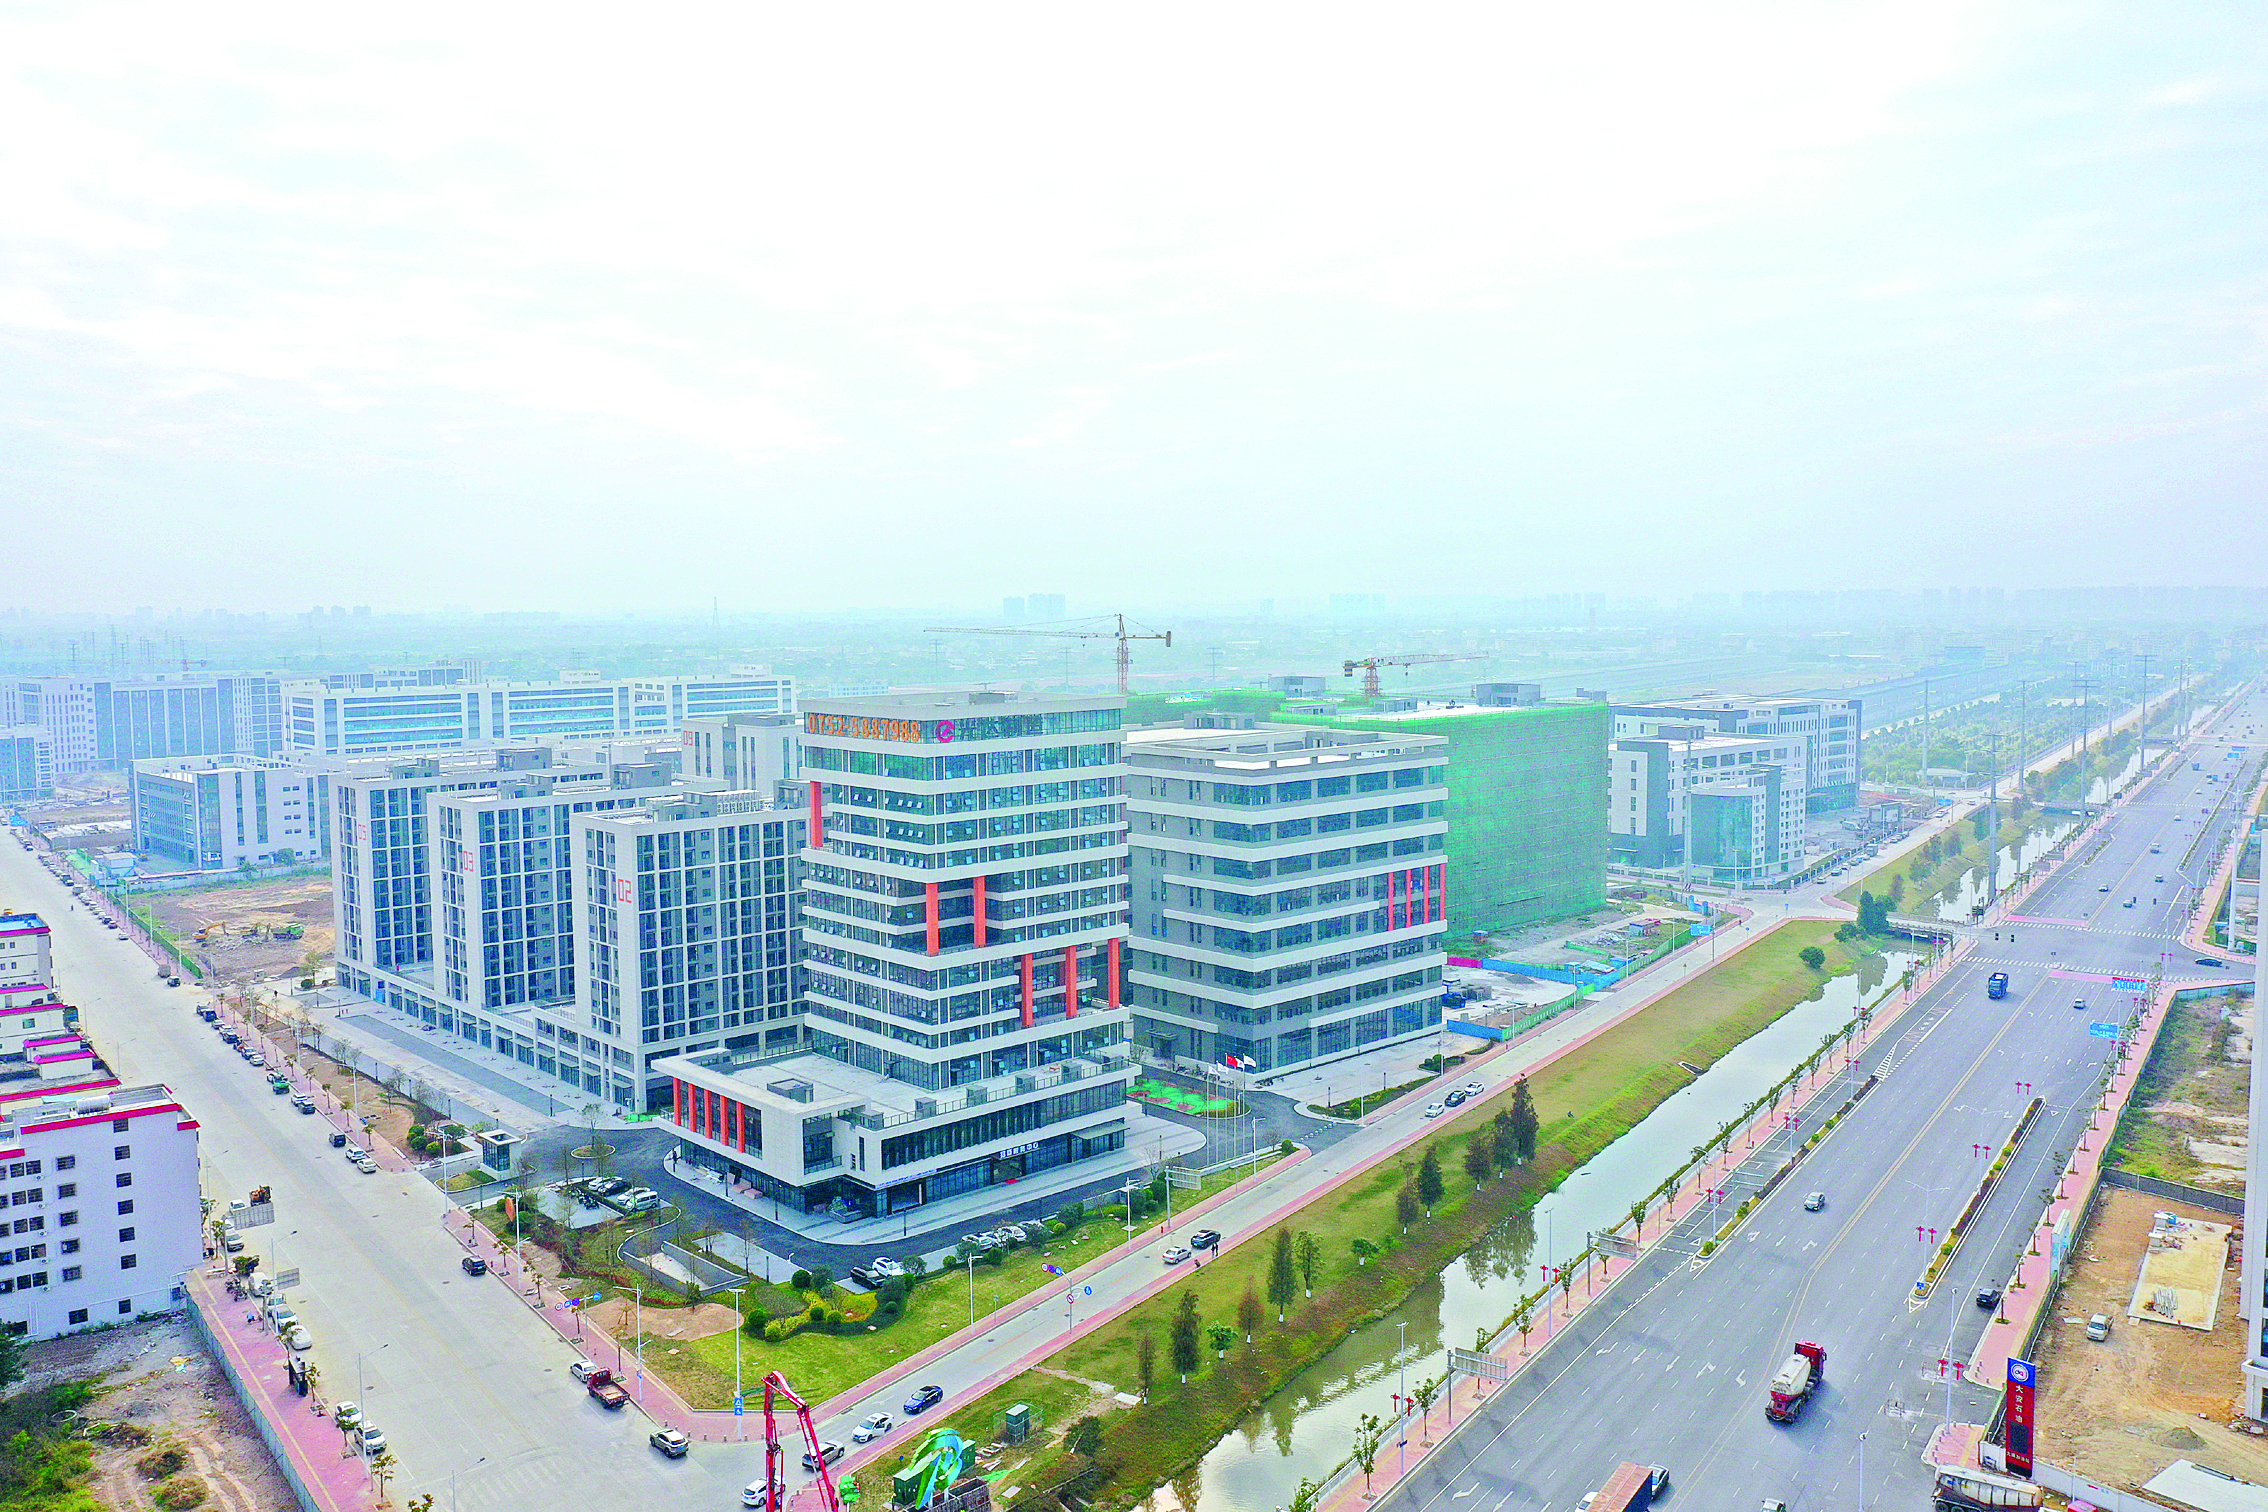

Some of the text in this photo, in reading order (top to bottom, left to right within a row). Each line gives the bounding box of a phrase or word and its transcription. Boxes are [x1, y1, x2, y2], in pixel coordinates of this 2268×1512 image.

[683, 730, 694, 746] 09
[808, 713, 921, 742] 0752-5887988
[358, 824, 367, 841] 05
[463, 850, 475, 872] 03
[618, 878, 632, 904] 02
